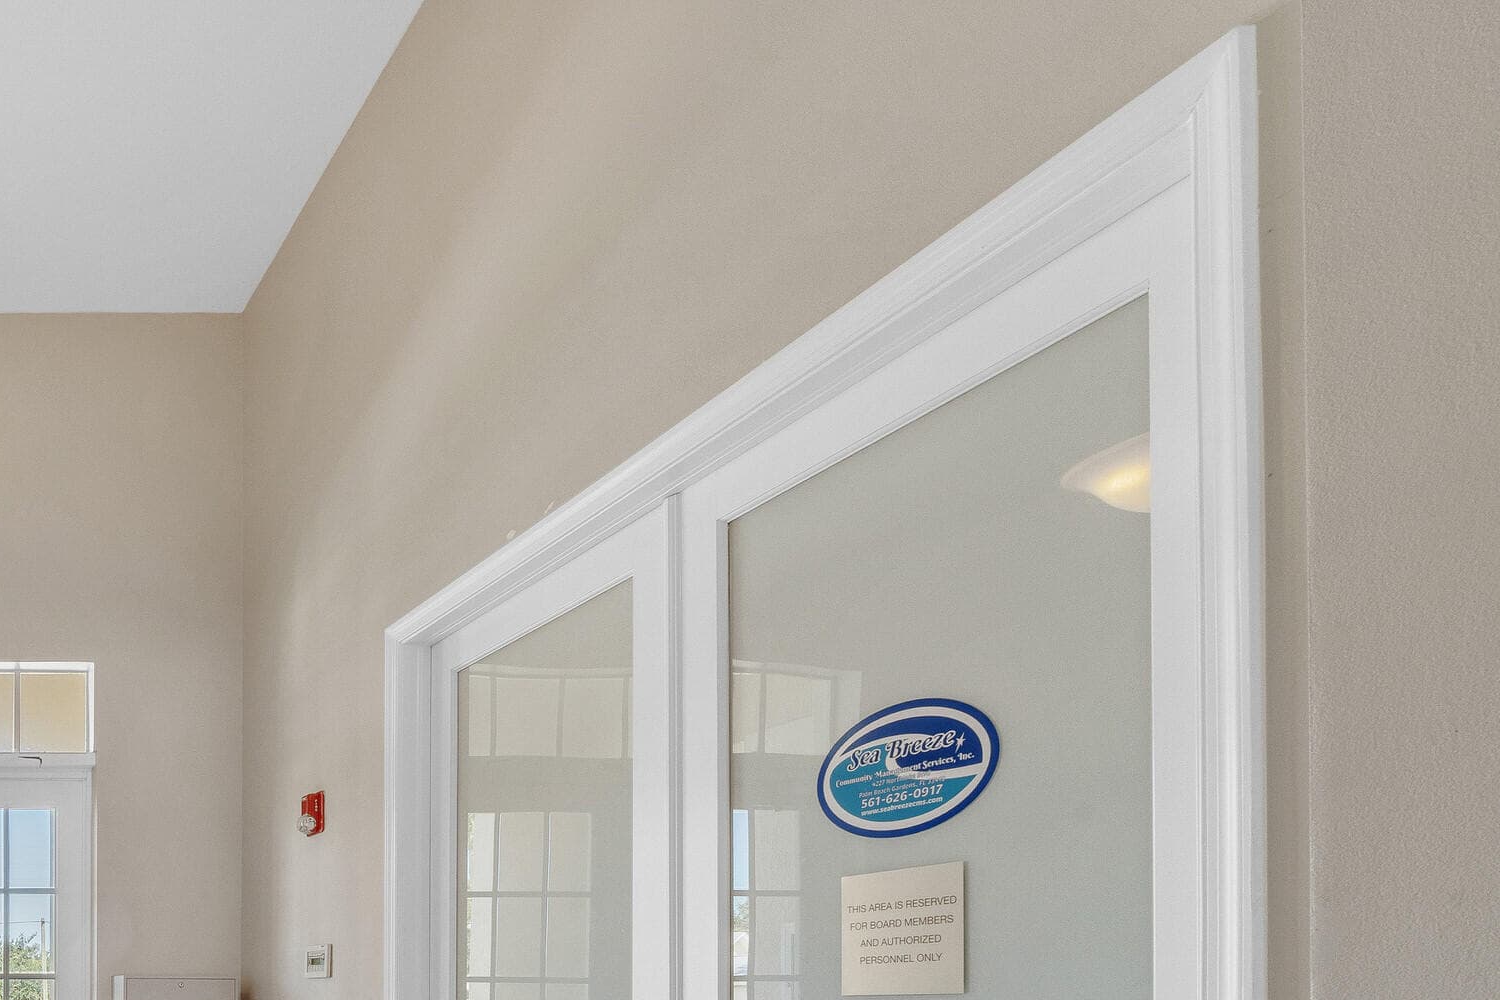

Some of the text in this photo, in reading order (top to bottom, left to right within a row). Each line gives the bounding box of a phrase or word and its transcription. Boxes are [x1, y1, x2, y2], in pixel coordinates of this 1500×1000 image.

[847, 730, 957, 771] Sea Breeze
[835, 775, 873, 788] Community
[922, 757, 956, 770] Services,
[957, 752, 975, 761] Inc.
[861, 784, 943, 808] 561-626-0917
[847, 895, 957, 914] THIS AREA IS RESERVED
[850, 914, 954, 931] FOR BOARD MEMBERS
[860, 934, 942, 947] AND AUTHORIZED
[860, 952, 943, 965] PERSONNEL ONLY
